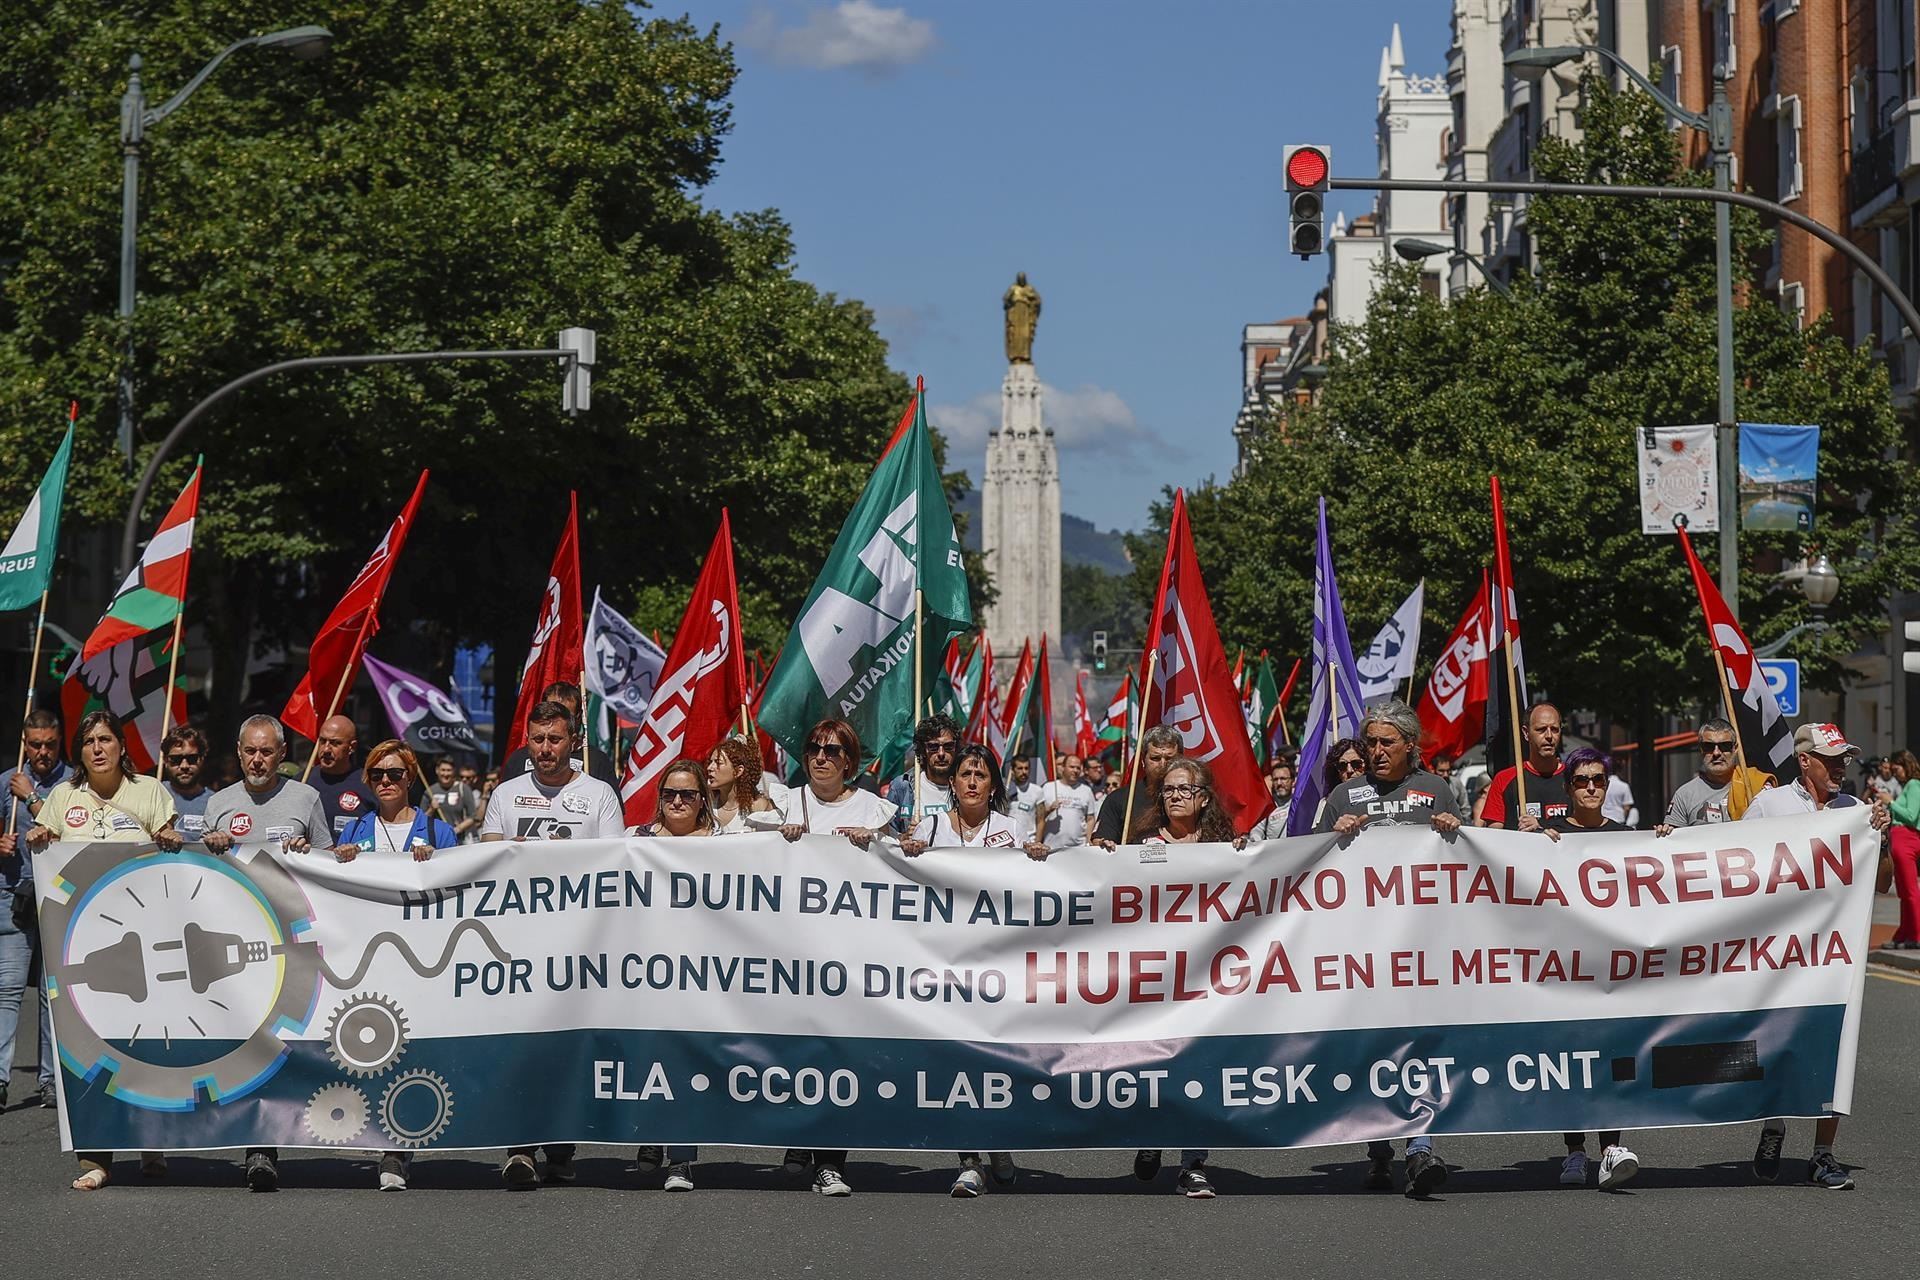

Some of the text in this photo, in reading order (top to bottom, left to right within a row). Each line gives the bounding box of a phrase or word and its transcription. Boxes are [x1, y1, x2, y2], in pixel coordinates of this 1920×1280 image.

[987, 832, 1011, 846] LAB
[1547, 807, 1567, 816] CNT
[401, 834, 1853, 927] HITZARMEN DUIN BATEN ALDE BIZKAIKO METALA GREBAN
[454, 930, 1853, 1005] POR UN CONVENIO DIGNO HUELGA EN EL METAL DE BIZKAIA
[593, 1050, 1600, 1110] ELA CCOO LAB UGT ESK CGT CNT
